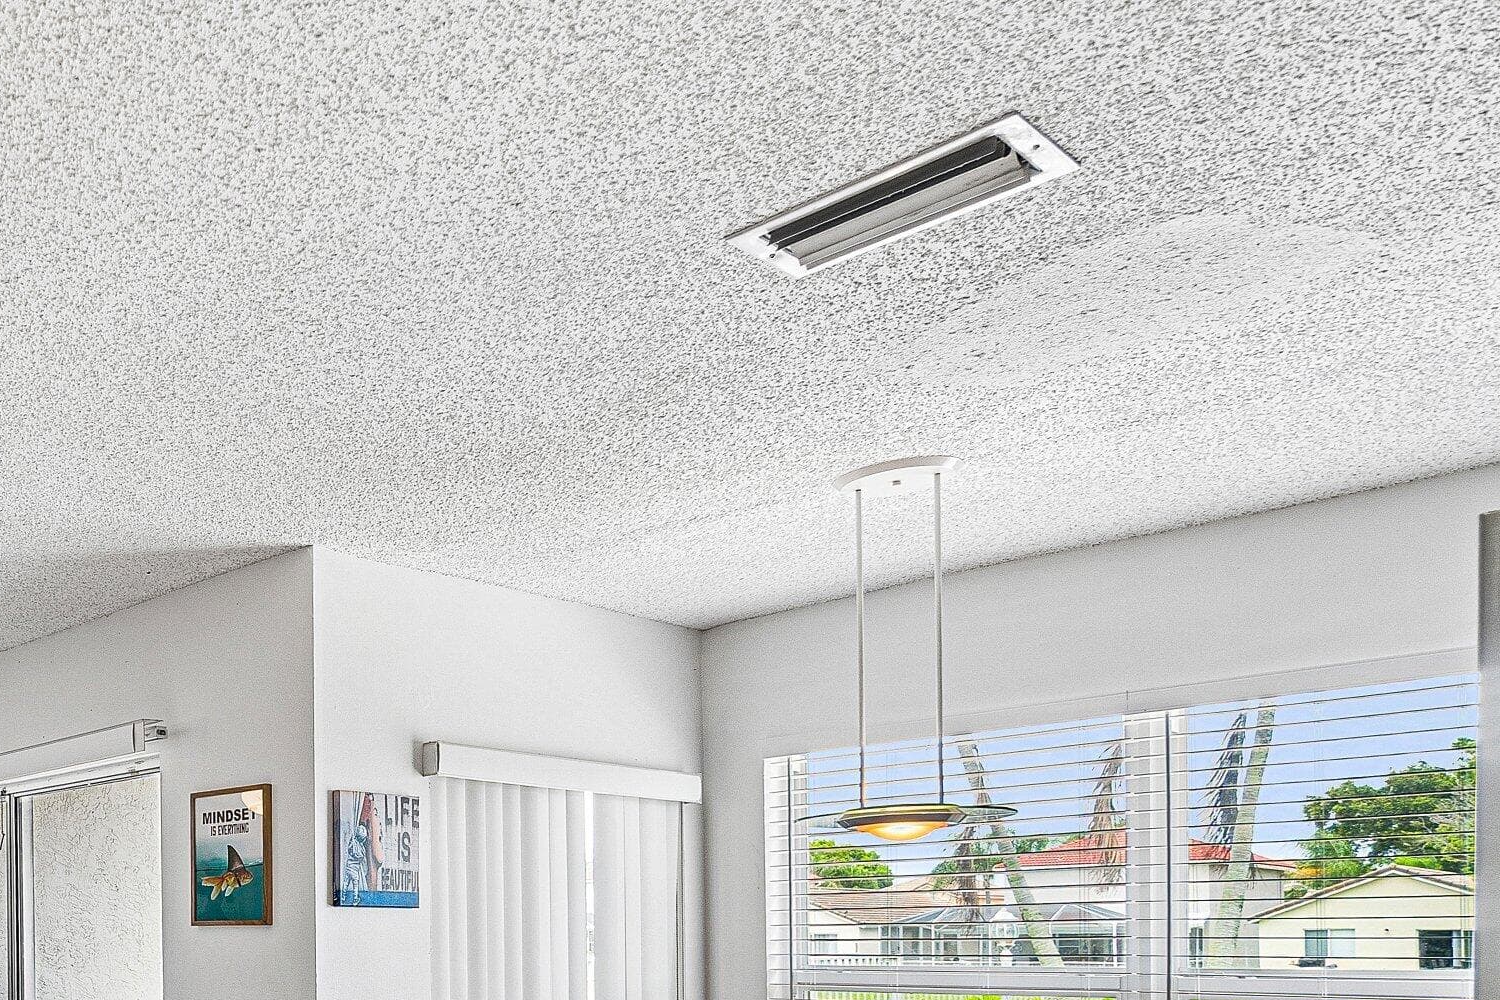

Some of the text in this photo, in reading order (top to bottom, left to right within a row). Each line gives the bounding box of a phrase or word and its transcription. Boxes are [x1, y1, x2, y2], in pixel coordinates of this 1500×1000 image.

[384, 794, 420, 829] LIFE
[211, 822, 249, 836] IS EVERYTHING
[397, 831, 411, 863] IS
[381, 867, 420, 891] BEAUTIFUL
